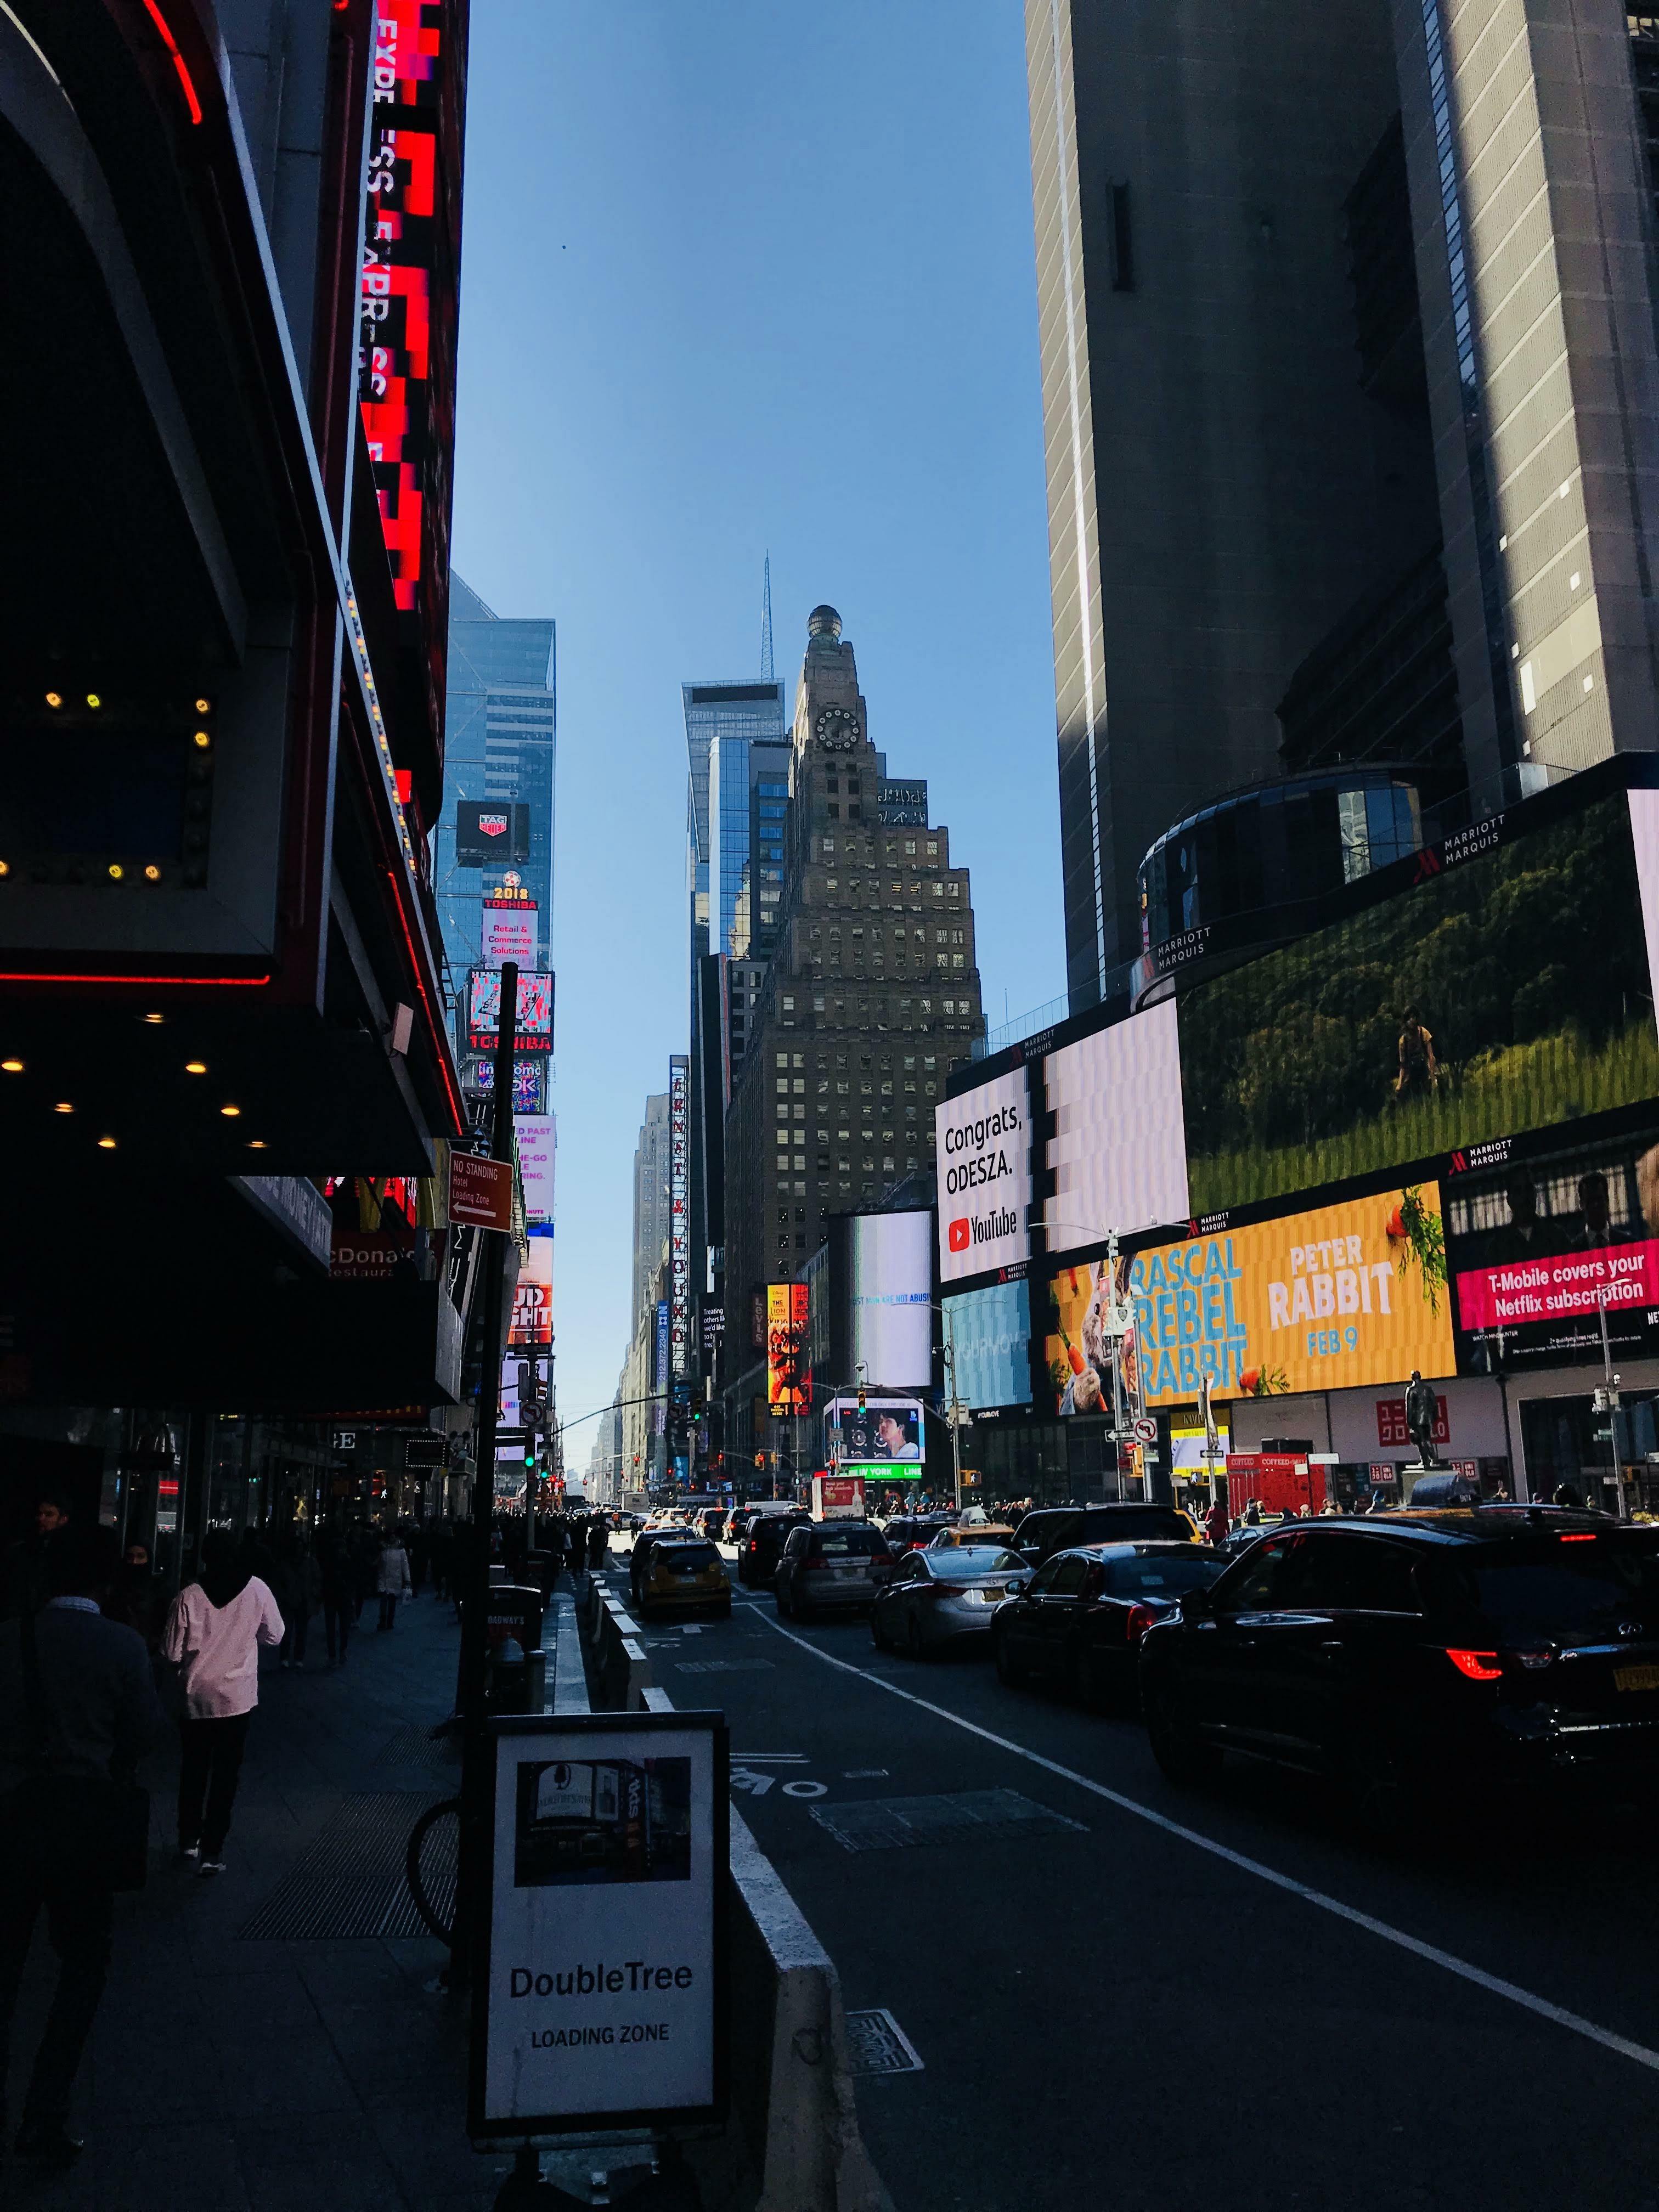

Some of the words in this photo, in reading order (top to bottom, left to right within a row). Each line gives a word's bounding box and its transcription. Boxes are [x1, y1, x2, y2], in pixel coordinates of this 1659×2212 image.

[481, 823, 505, 834] HEUER
[1445, 814, 1505, 850] MARRIOTT
[1446, 832, 1499, 865] MARQUIS
[485, 900, 537, 910] TOSHIBA
[494, 887, 528, 900] 2018
[488, 935, 532, 944] Commerce
[490, 946, 529, 955] Solutions
[1158, 927, 1210, 957] MARRIOTT
[1159, 943, 1204, 970] MARQUIS
[469, 1035, 551, 1050] TOIBA
[1025, 1029, 1054, 1048] MARRIOTT
[1025, 1041, 1052, 1059] MARQUIS
[945, 1106, 1022, 1154] Congrats,
[1470, 1139, 1512, 1157] MARRIOTT
[1471, 1150, 1508, 1167] MARQUIS
[453, 1160, 464, 1173] NO
[466, 1162, 498, 1181] STANDING
[453, 1175, 468, 1187] Hotel
[946, 1149, 1013, 1195] ODESZA.
[453, 1189, 474, 1204] Loading
[476, 1193, 489, 1205] Zone
[971, 1206, 1017, 1244] YouTube
[1201, 1211, 1229, 1224] MARRIOTT
[1201, 1221, 1227, 1233] MARQUIS
[1130, 1238, 1243, 1295] RASCAL
[1290, 1234, 1363, 1276] PETER
[1488, 1267, 1549, 1293] T-Mobile
[1553, 1261, 1605, 1284] covers
[1608, 1255, 1645, 1279] your
[896, 1294, 908, 1303] NOT
[1268, 1261, 1394, 1331] RABBIT
[1496, 1293, 1543, 1317] Netflix
[1546, 1282, 1644, 1310] subscription
[1133, 1281, 1247, 1349] REBEL
[1307, 1329, 1341, 1357] FEB
[1344, 1325, 1358, 1352] 9
[658, 1328, 667, 1381] 212.372.2349
[1141, 1339, 1248, 1396] RABBIT
[870, 1468, 892, 1476] YORK
[904, 1467, 922, 1476] LINE
[510, 1961, 692, 1998] DoubleTree
[532, 2026, 614, 2049] LOADING
[620, 2023, 670, 2045] ZONE
